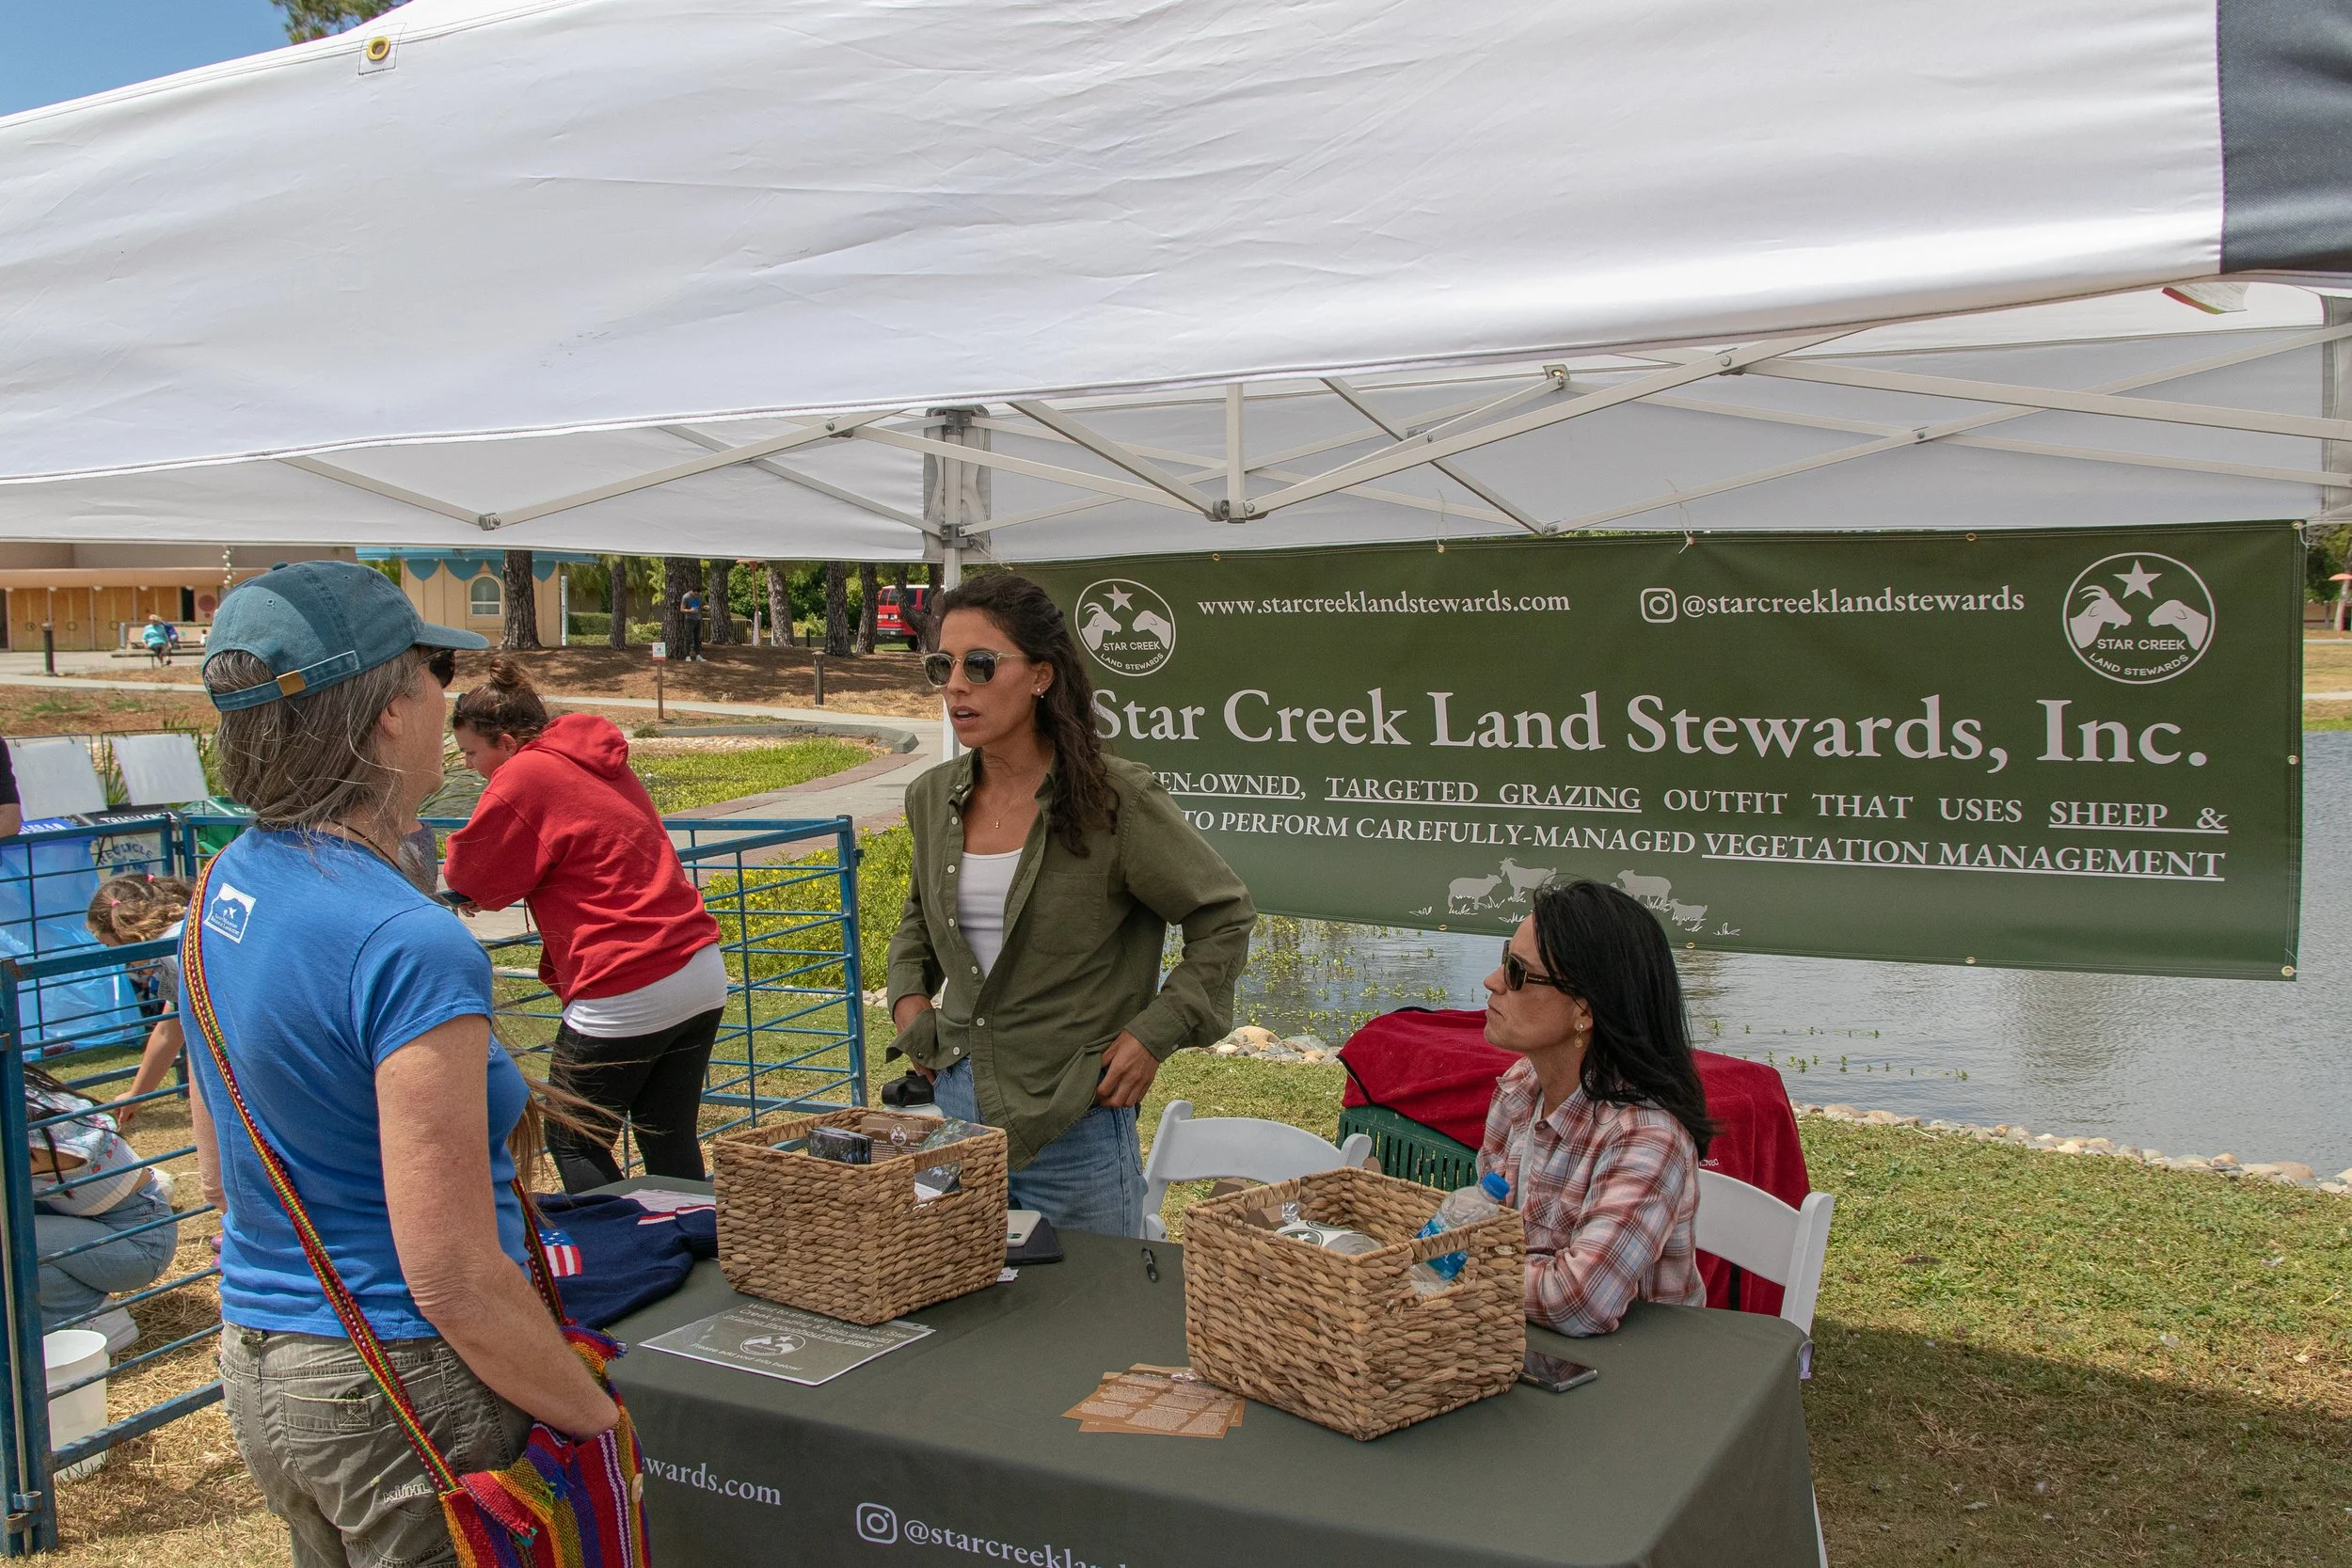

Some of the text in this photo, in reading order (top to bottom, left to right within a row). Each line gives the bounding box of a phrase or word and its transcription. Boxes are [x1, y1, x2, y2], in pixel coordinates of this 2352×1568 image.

[1197, 589, 1571, 615] www.starcreeklandstewards.com
[1682, 585, 2025, 618] @starcreeklandstewards
[1103, 641, 1161, 651] STAR CREEK
[2097, 639, 2186, 651] STAR CREEK
[1100, 653, 1164, 671] LAND STEWARDS
[2089, 653, 2189, 676] LAND STEWARDS
[1091, 687, 2207, 774] Star Creek Land Stewards, Inc.
[1152, 771, 2229, 830] EN-OWNED, TARGETED GRAZING OUTFIT THAT USES SHEEP &
[1182, 810, 2227, 877] TO PERFORM CAREFULLY-MANAGED VEGETATION MANAGEMENT
[642, 1457, 782, 1506] wards.com
[904, 1519, 1126, 1568] @starcreekl
